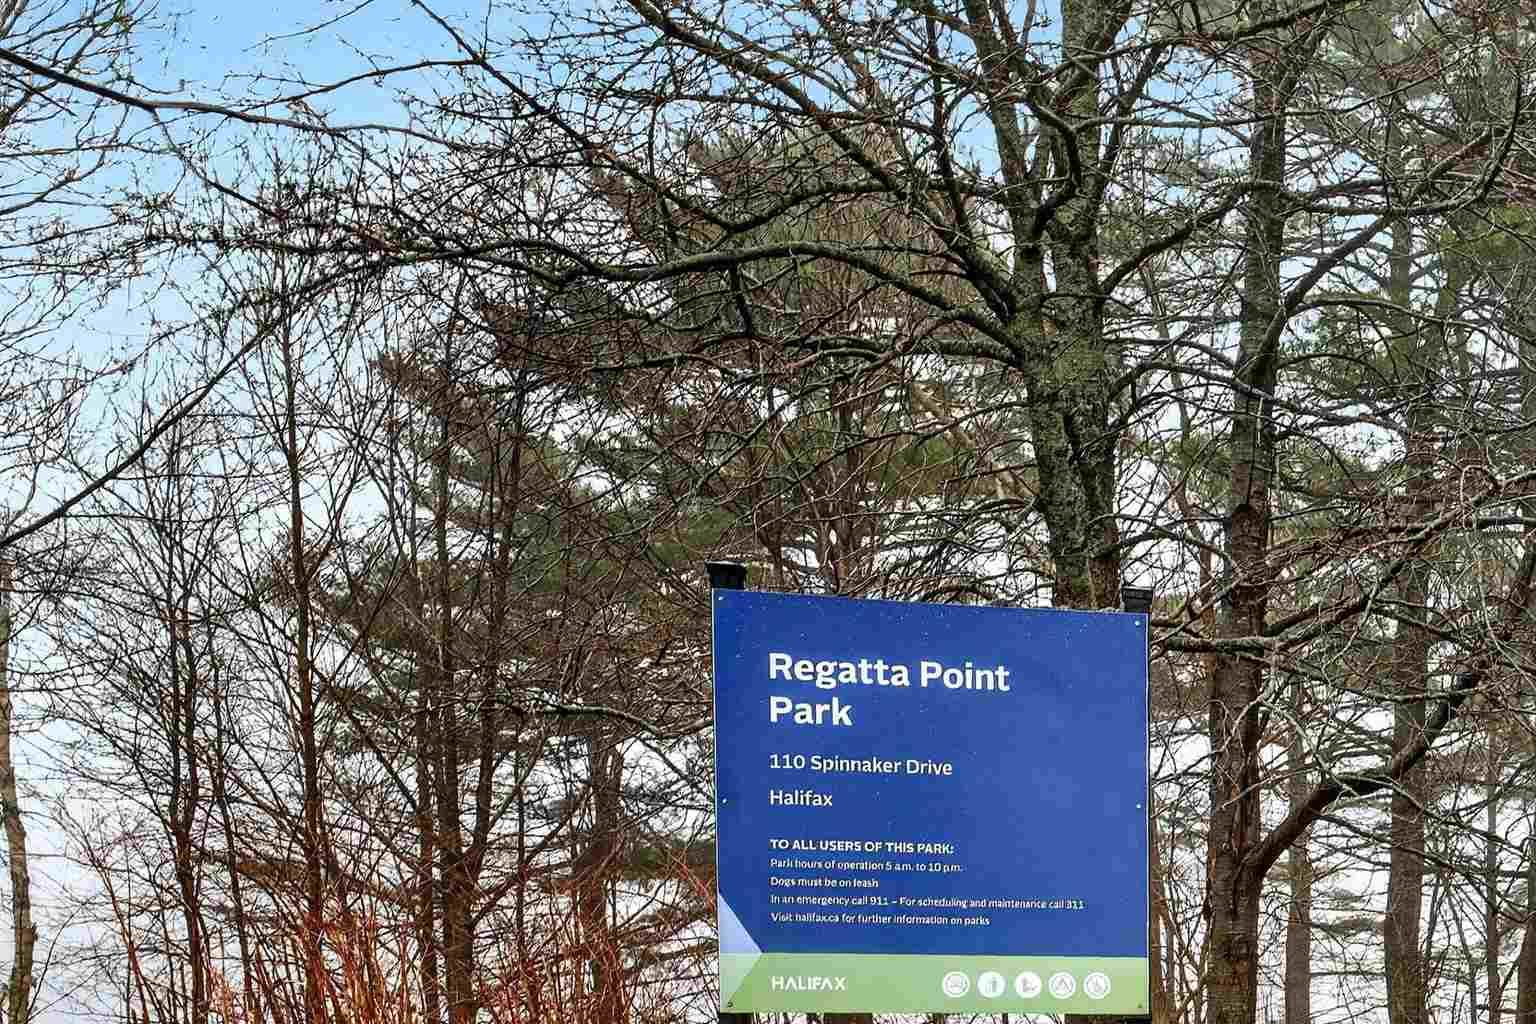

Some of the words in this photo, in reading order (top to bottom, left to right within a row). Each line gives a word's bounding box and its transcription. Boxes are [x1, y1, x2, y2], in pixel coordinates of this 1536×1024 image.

[768, 652, 910, 690] Regatta
[919, 660, 1010, 692] Point
[769, 695, 853, 726] Park
[769, 753, 806, 769] 110
[811, 754, 901, 773] Spinnaker
[906, 759, 953, 776] Drive
[769, 789, 833, 807] Halifax
[770, 839, 790, 849] TO
[791, 840, 817, 850] ALL
[819, 840, 862, 852] USERS
[864, 841, 883, 852] OF
[885, 842, 914, 853] THIS
[917, 843, 955, 854] PARK:
[770, 858, 794, 868] Park
[795, 859, 823, 869] hours
[824, 860, 836, 869] of
[837, 861, 884, 872] operation
[885, 861, 893, 871] 5
[916, 863, 927, 872] to
[928, 863, 942, 872] 10
[770, 877, 796, 889] Dogs
[798, 878, 823, 887] must
[824, 878, 838, 888] be
[839, 880, 852, 888] on
[853, 878, 879, 888] leash
[771, 895, 781, 904] In
[782, 896, 795, 905] an
[797, 896, 850, 907] emergency
[851, 896, 868, 906] call
[870, 897, 888, 906] 911
[900, 897, 916, 906] For
[918, 898, 967, 909] scheduling
[969, 899, 987, 908] and
[988, 899, 1047, 909] maintenance
[1048, 899, 1065, 909] call
[1066, 900, 1084, 910] 311
[771, 913, 793, 922] Visit
[841, 912, 855, 924] for
[857, 914, 890, 925] further
[893, 915, 949, 926] information
[951, 916, 963, 926] on
[964, 915, 990, 927] parks
[771, 976, 847, 992] HALIFAX
